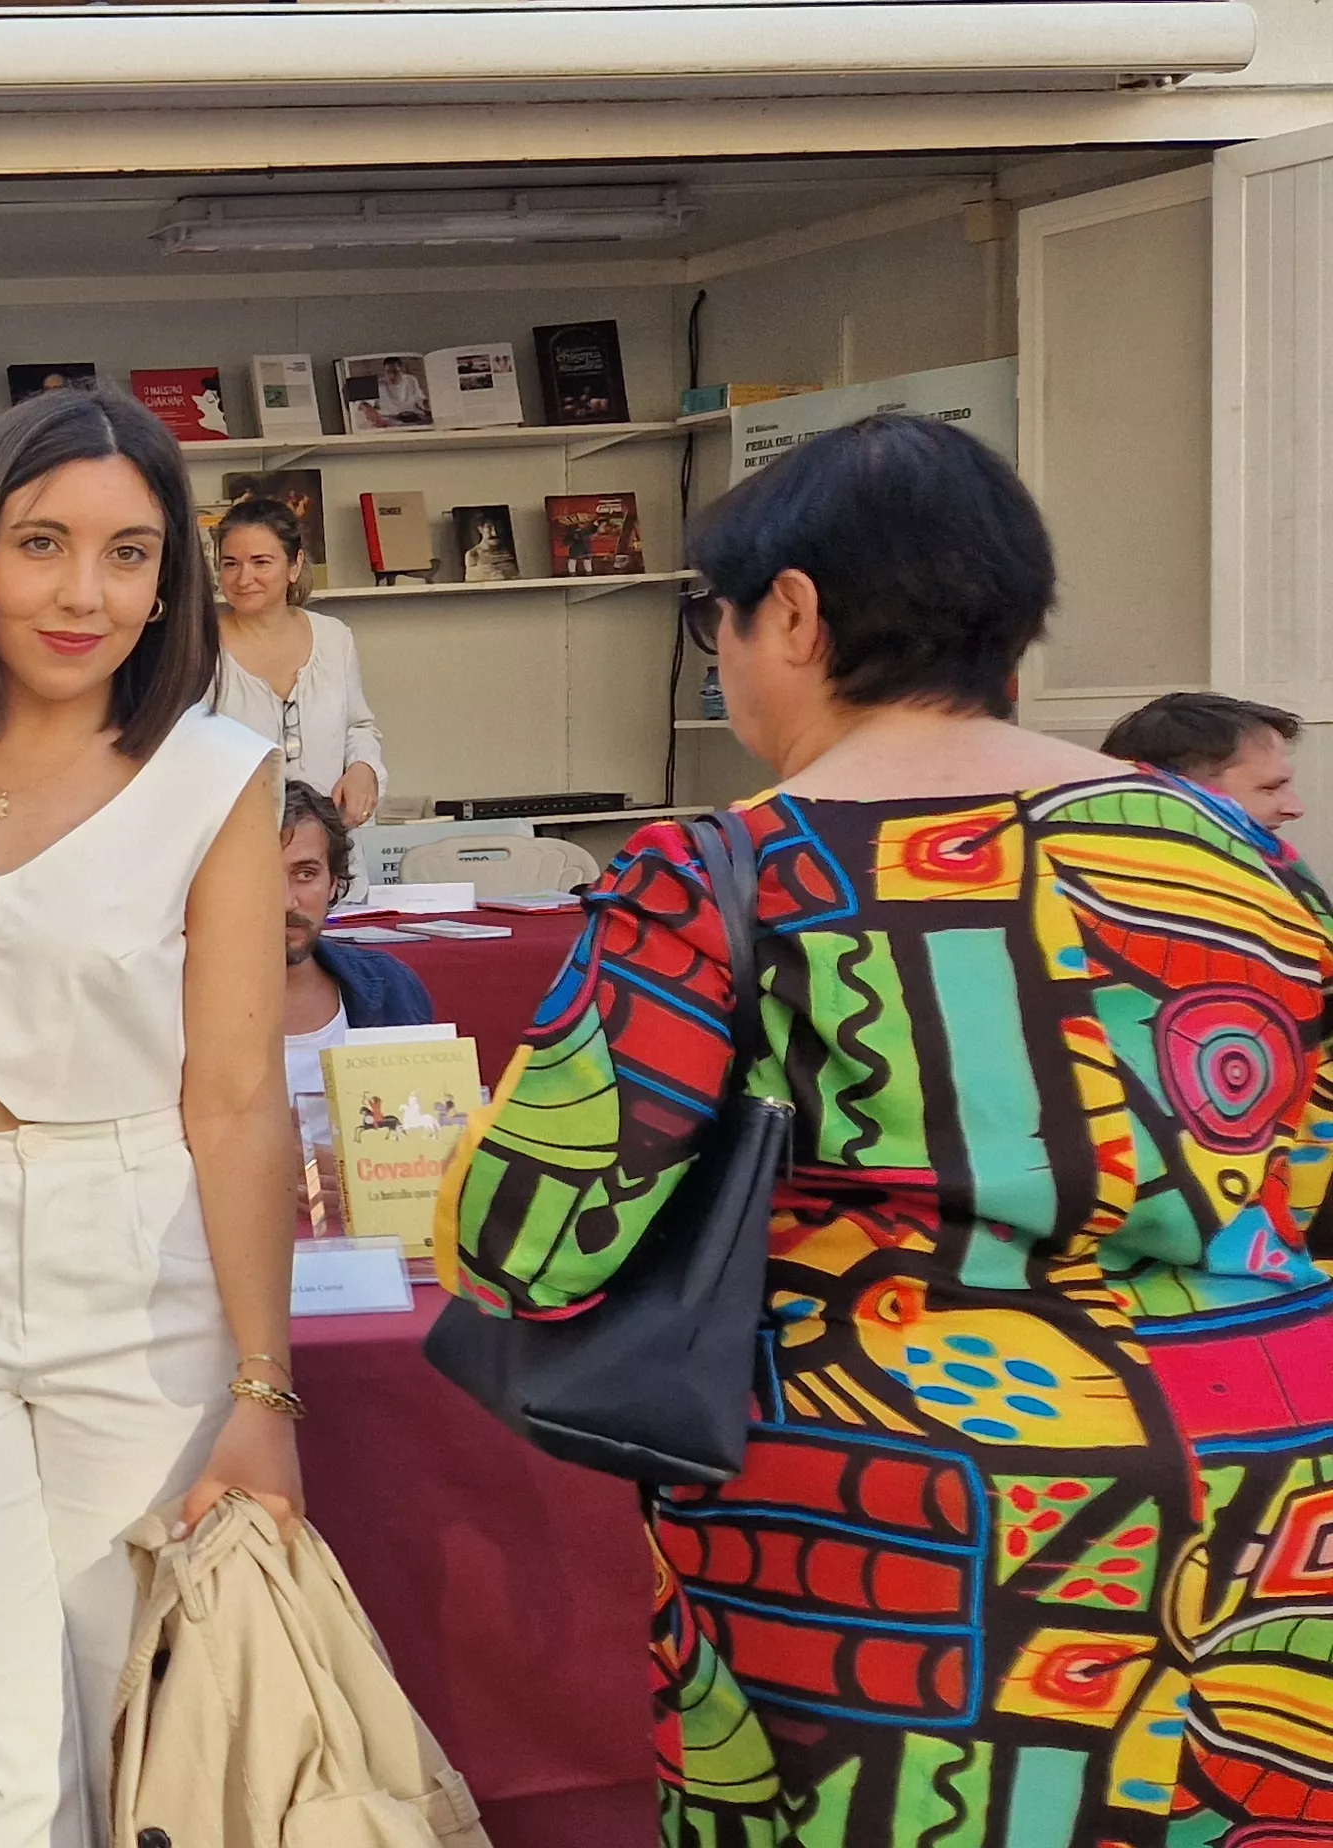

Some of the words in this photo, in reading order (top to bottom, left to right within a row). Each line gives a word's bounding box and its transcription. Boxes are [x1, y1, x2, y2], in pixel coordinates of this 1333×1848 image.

[345, 1053, 379, 1070] JOSÉ
[381, 1053, 409, 1067] LUIS
[413, 1050, 466, 1066] CORRAL
